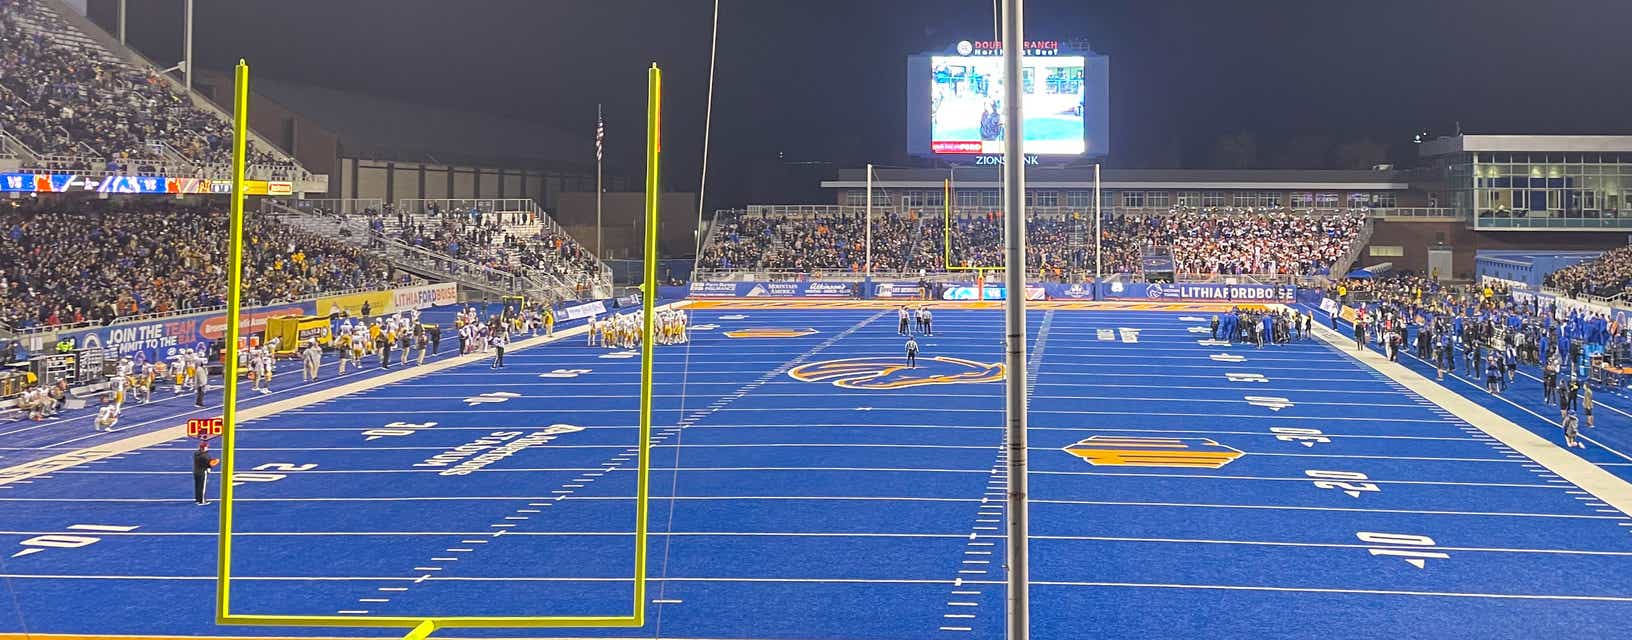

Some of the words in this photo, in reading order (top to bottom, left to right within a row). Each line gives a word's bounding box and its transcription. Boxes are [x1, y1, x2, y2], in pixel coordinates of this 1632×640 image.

[975, 41, 1002, 49] DOUB
[1024, 41, 1057, 49] RANCH
[1036, 48, 1058, 56] Beef
[976, 156, 1005, 165] ZIONS
[394, 287, 456, 307] LITHIAFORDBOISE
[106, 328, 137, 345] JOIN
[139, 324, 163, 340] THE
[165, 320, 196, 336] TEAM
[145, 339, 158, 349] TO
[160, 335, 178, 347] THE
[412, 431, 524, 467] STADIUM
[231, 463, 319, 482] 20
[1305, 470, 1381, 491] 20
[19, 523, 142, 548] 10
[1356, 531, 1451, 559] 10
